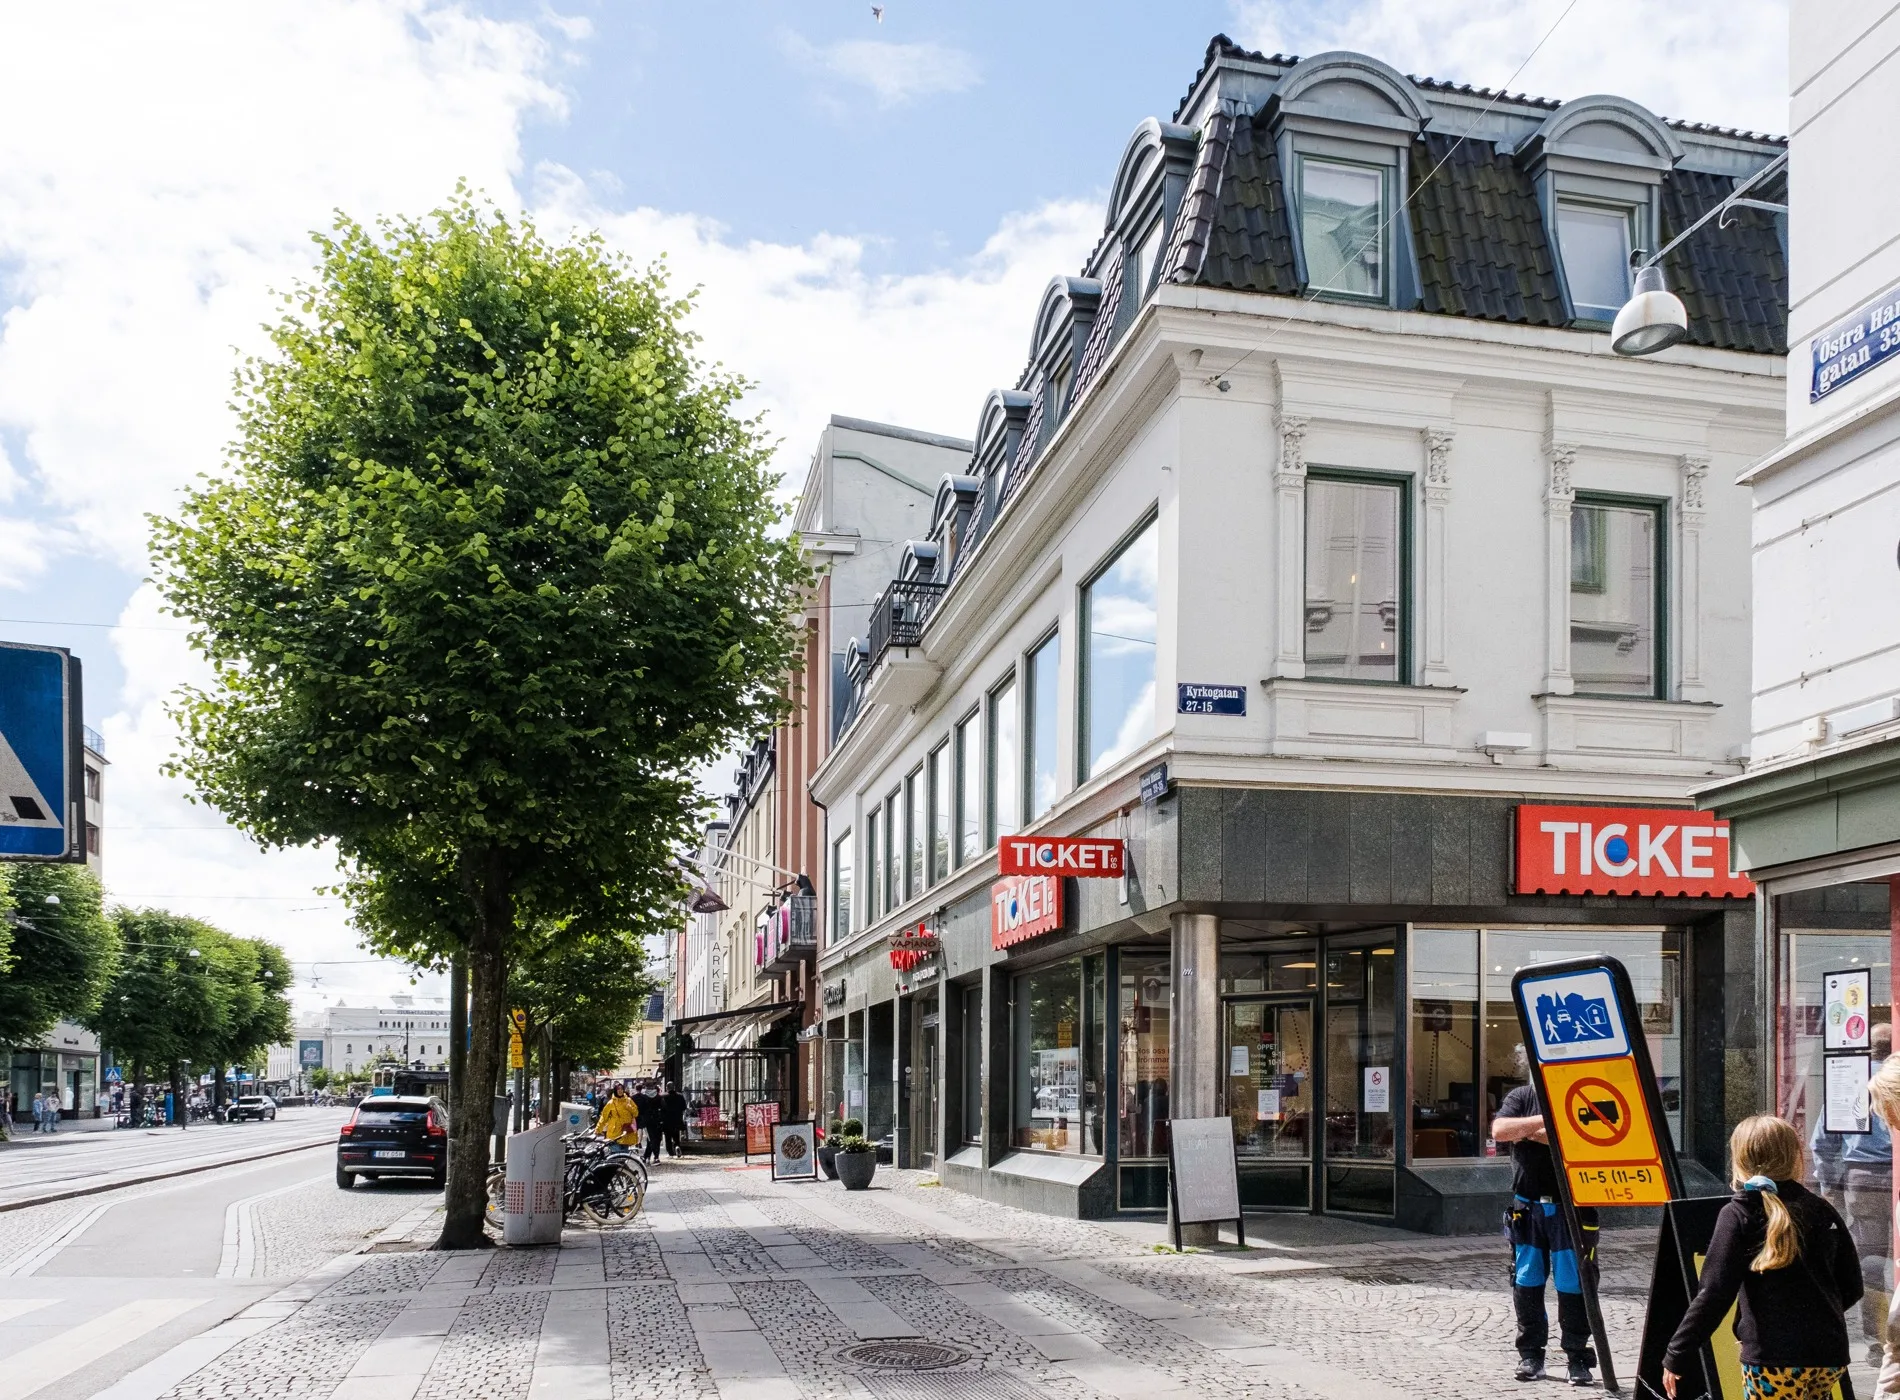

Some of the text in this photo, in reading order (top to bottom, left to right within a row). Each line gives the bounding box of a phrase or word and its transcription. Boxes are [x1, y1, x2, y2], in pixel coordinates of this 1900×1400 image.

[1819, 299, 1900, 364] Östra Ha
[1819, 345, 1871, 393] gatan
[1186, 686, 1239, 700] Kyrkogatan
[1186, 701, 1213, 713] 27-15
[1011, 842, 1114, 869] TICKET
[1540, 821, 1739, 878] TICKE
[995, 876, 1048, 935] TICKET
[890, 939, 937, 949] VAPIANO
[712, 942, 721, 1006] ARKET
[748, 1109, 778, 1118] SALE
[1579, 1168, 1652, 1184] 11-5 (11-5)
[1604, 1187, 1634, 1201] 11-5
